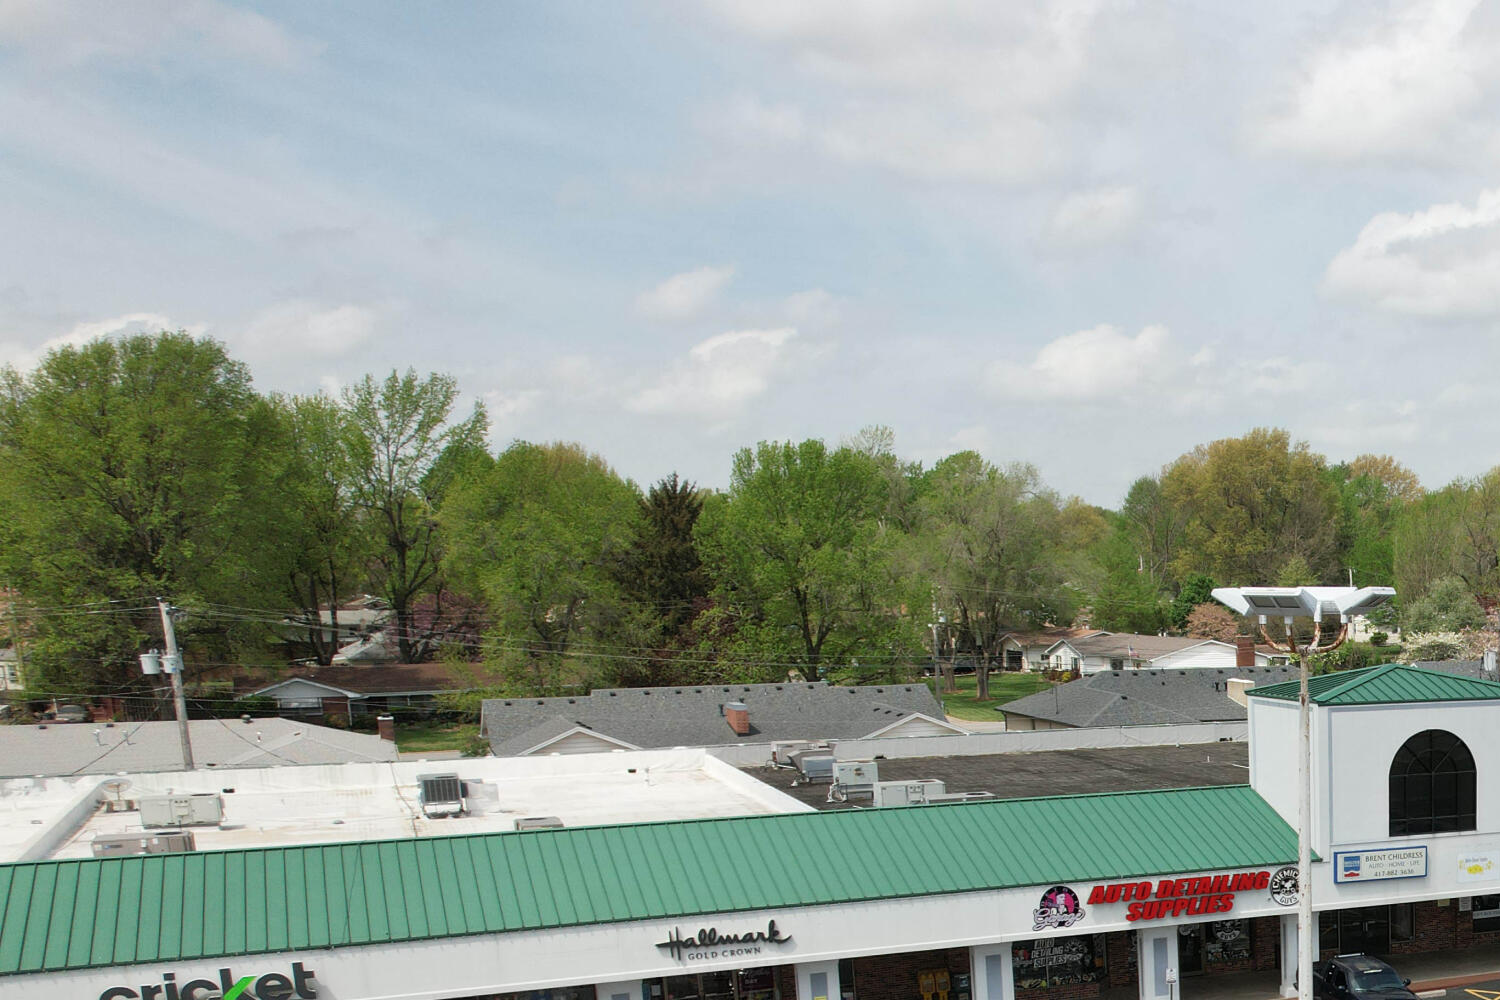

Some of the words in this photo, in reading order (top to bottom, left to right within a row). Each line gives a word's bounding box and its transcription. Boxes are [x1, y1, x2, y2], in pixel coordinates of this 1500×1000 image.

[1365, 854, 1386, 862] BRENT
[1388, 852, 1423, 861] CHILDRESS
[1087, 881, 1152, 905] AUTO
[1156, 871, 1270, 899] DETAILING
[1272, 869, 1300, 889] CHEMIC
[1126, 893, 1235, 921] SUPPLIES
[655, 919, 792, 961] Hallmark
[688, 952, 718, 961] GOLD
[722, 947, 761, 958] CROWN
